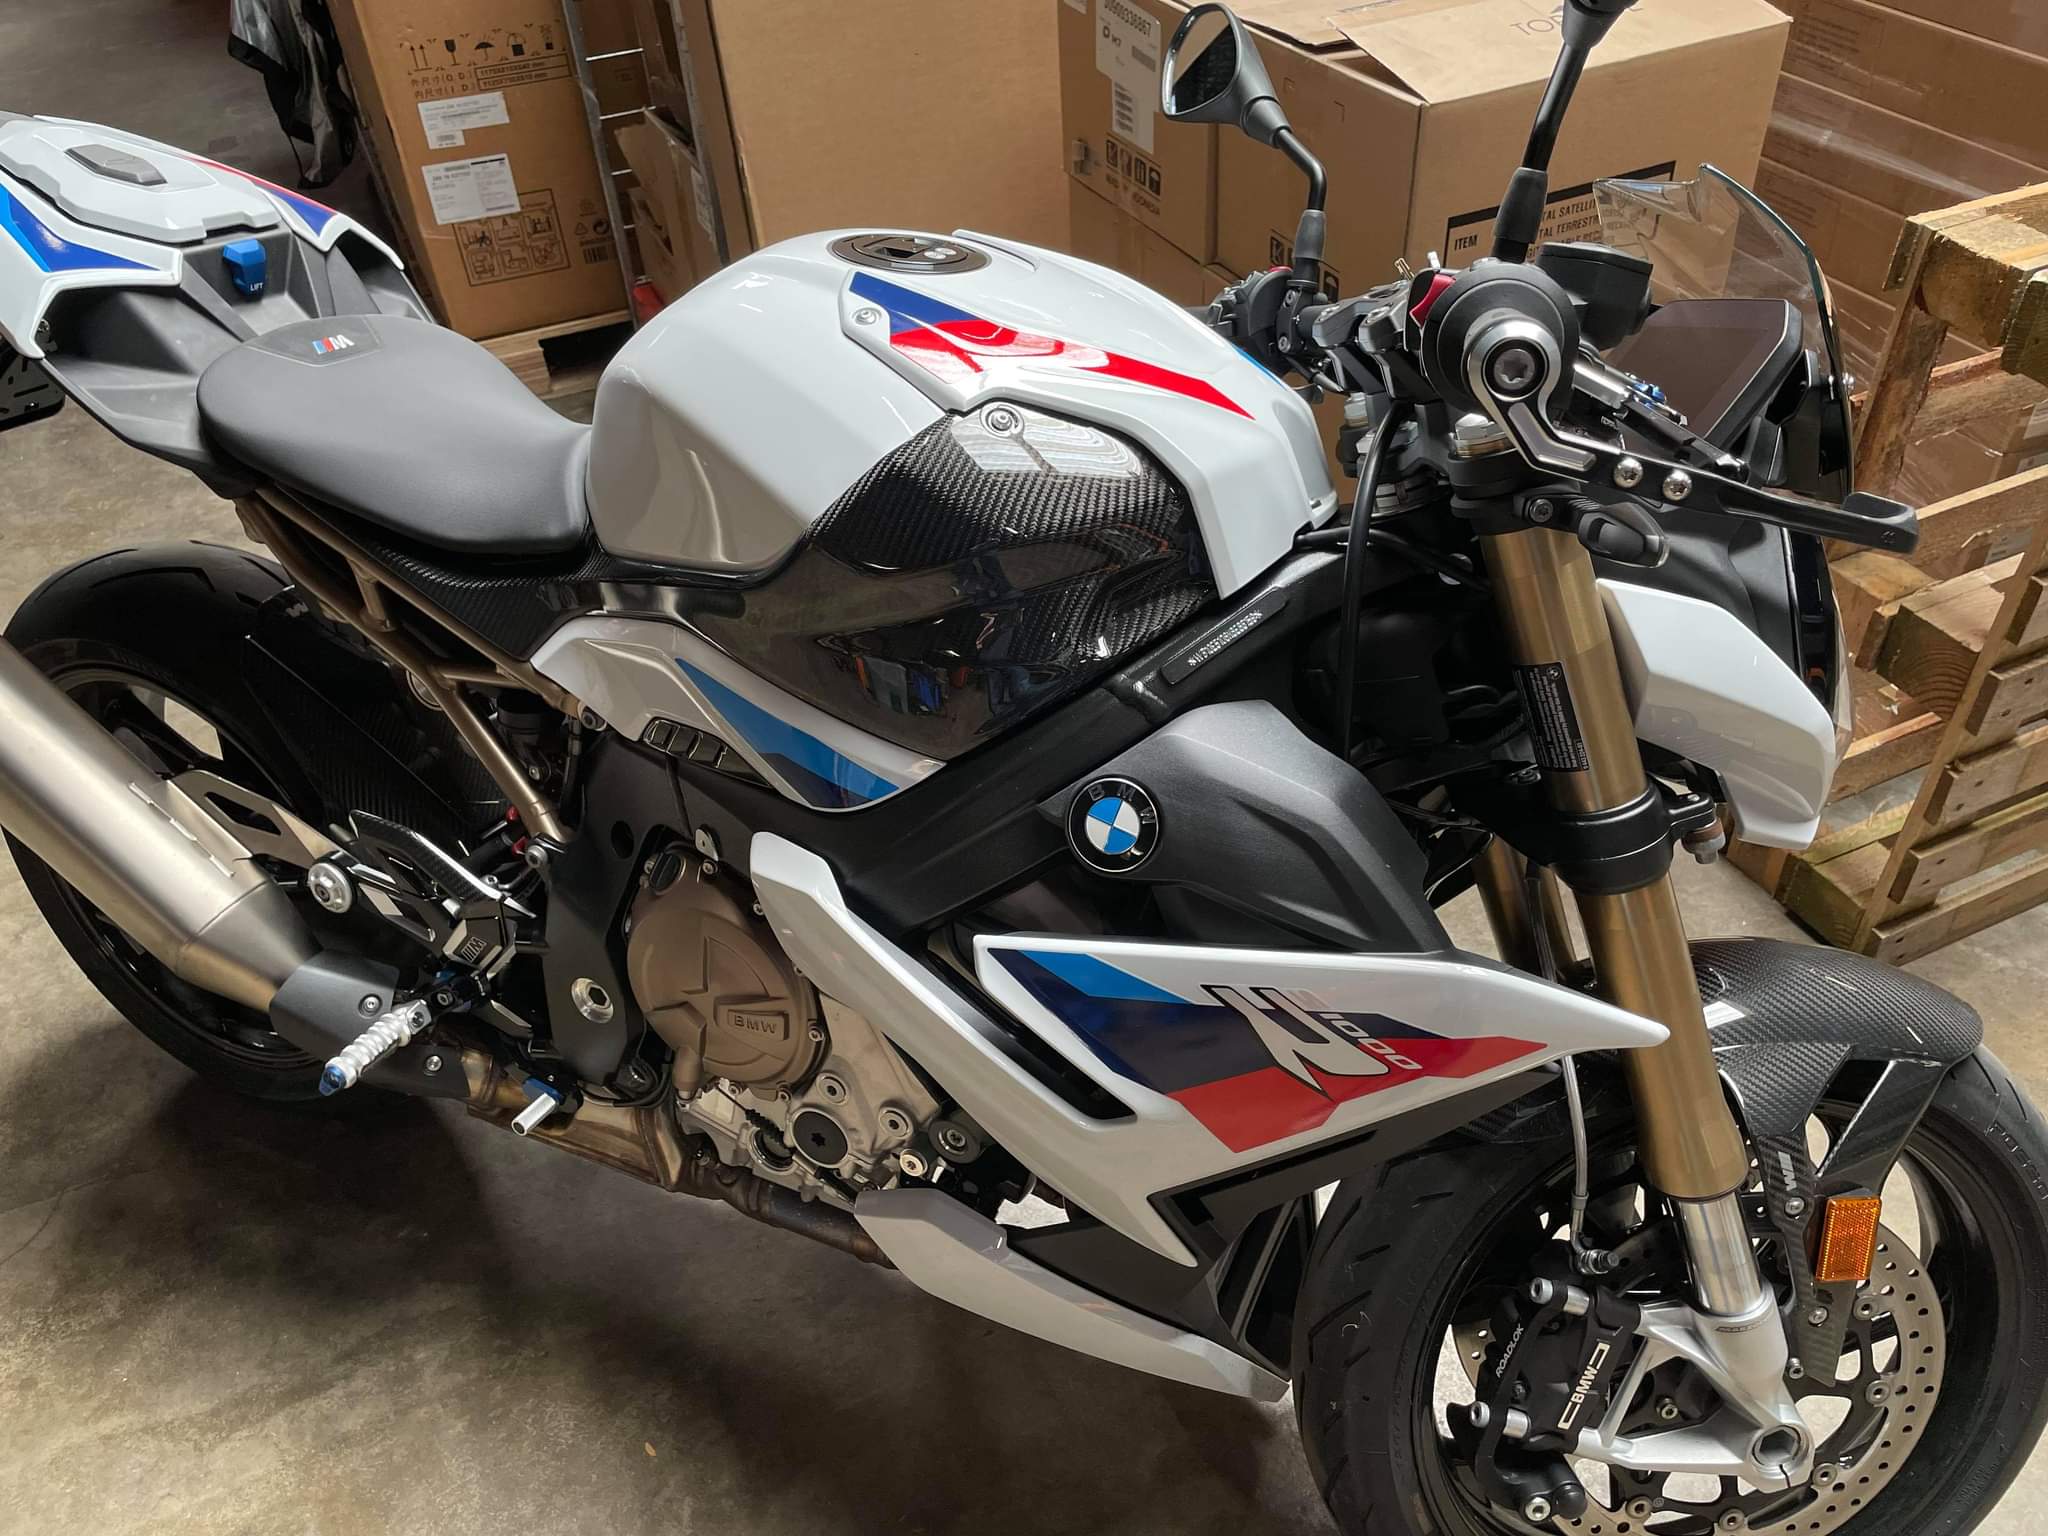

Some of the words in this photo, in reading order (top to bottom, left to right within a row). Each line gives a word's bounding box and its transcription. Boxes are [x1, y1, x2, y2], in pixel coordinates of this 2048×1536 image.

[1454, 234, 1478, 251] ITEM
[250, 281, 264, 291] LIFT
[734, 1014, 777, 1034] BMW
[1495, 1323, 1525, 1379] ROADLOK
[1570, 1365, 1599, 1404] BMW
